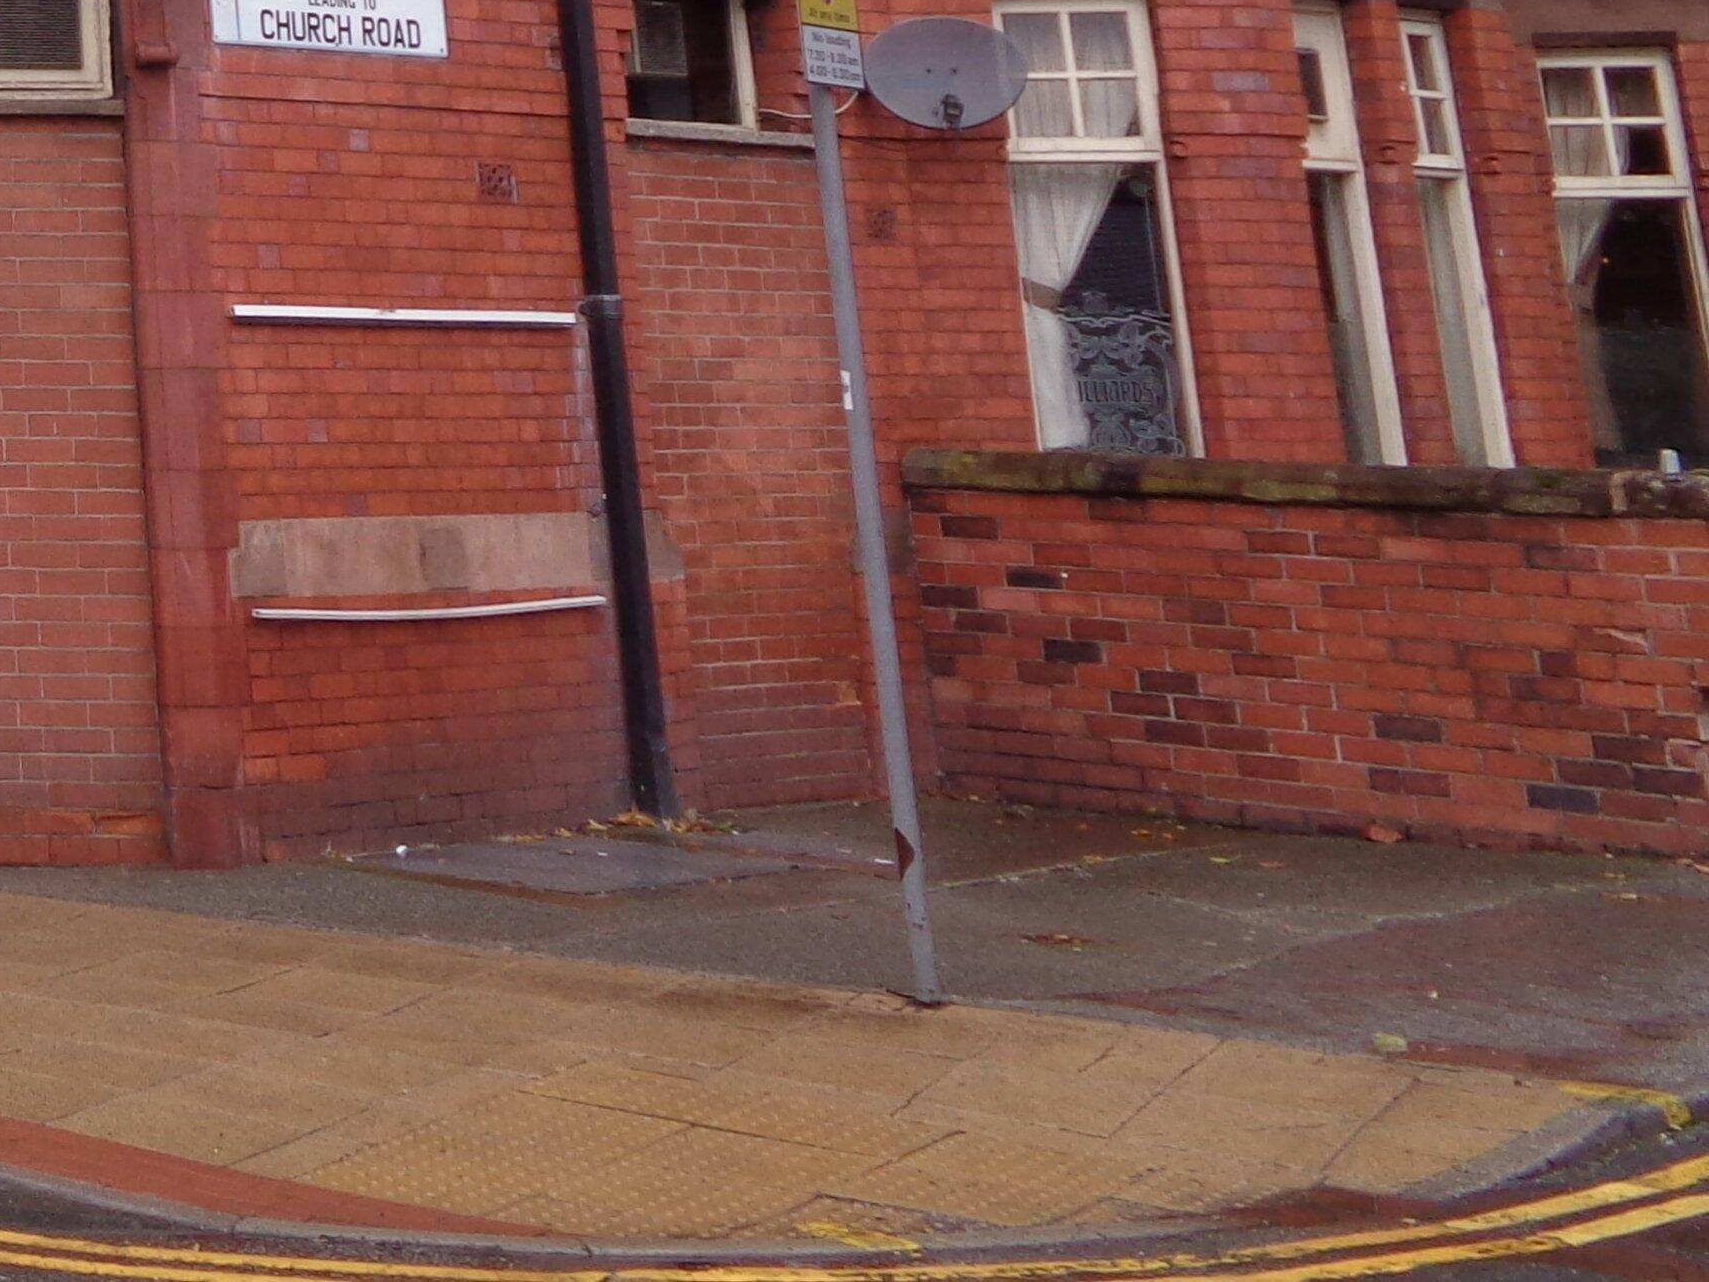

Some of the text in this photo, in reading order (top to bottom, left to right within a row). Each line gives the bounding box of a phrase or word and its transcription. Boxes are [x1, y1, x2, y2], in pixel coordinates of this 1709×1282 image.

[260, 9, 422, 48] CHURCH ROAD
[1077, 380, 1154, 403] ILLIARDS
